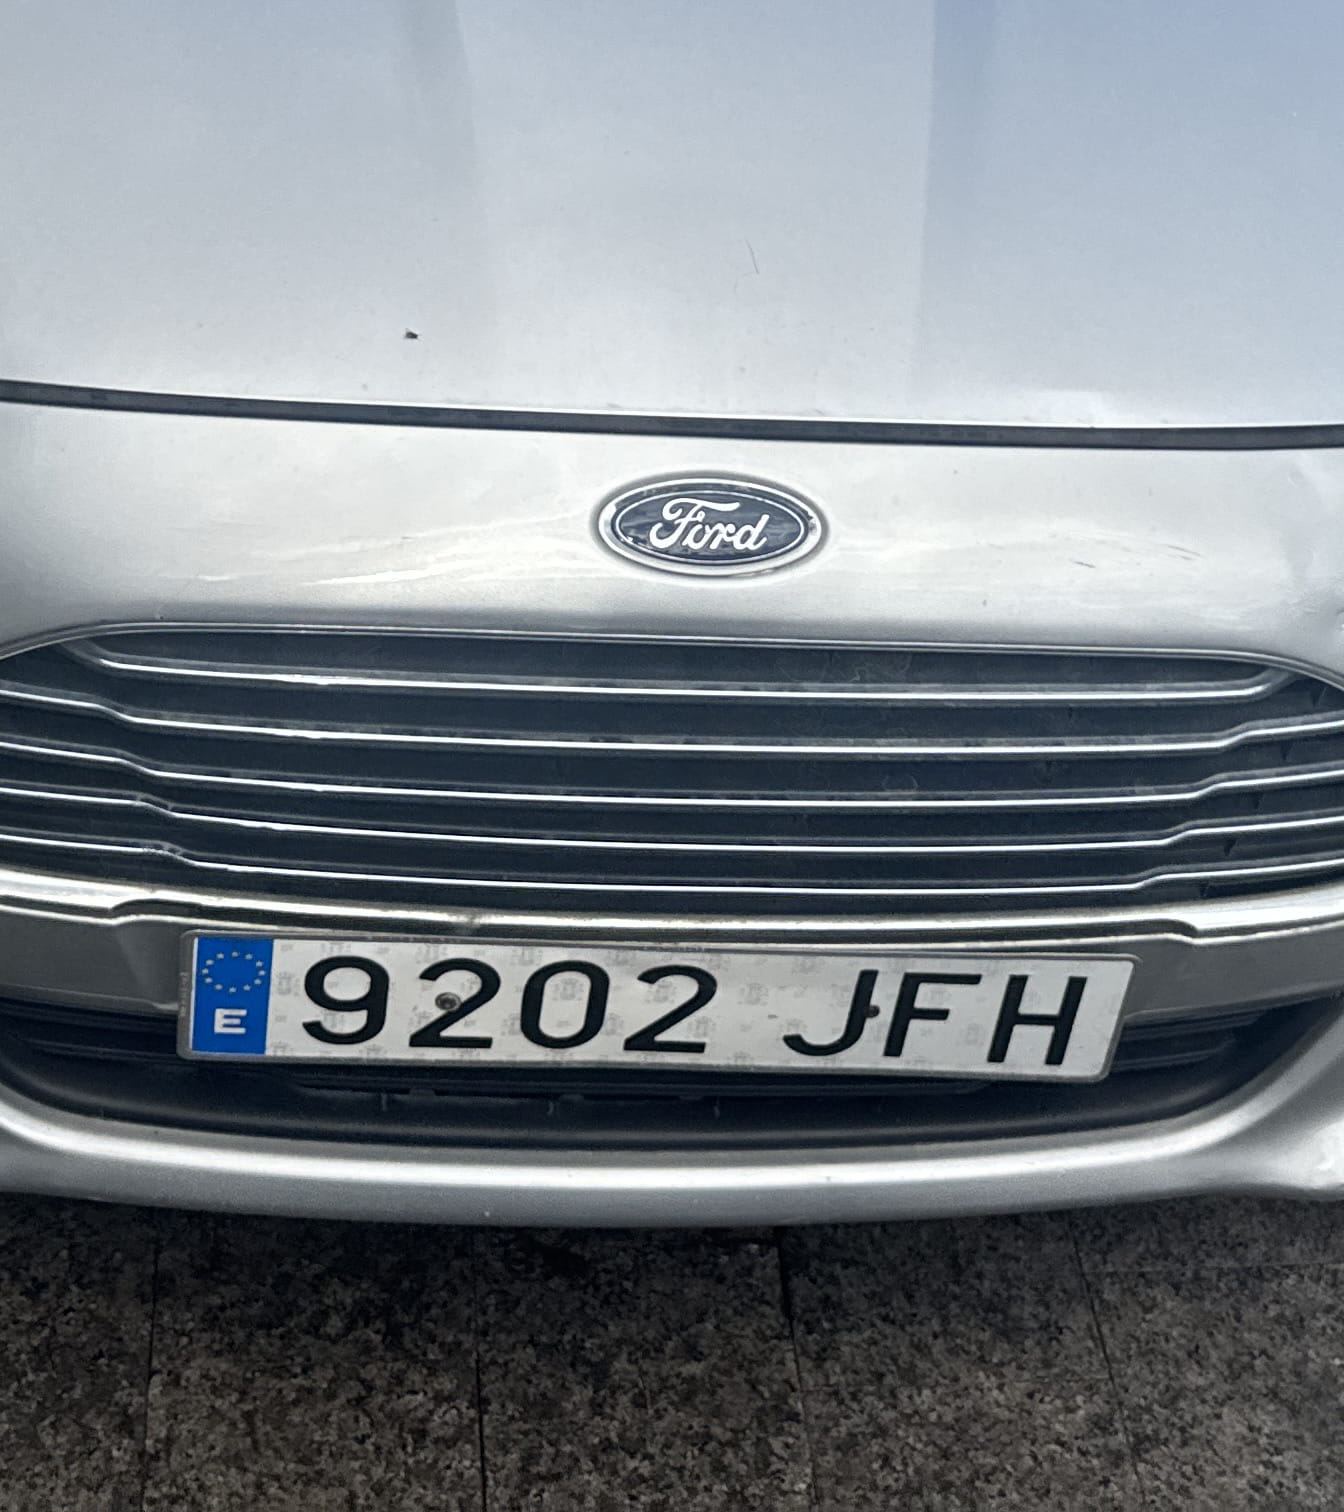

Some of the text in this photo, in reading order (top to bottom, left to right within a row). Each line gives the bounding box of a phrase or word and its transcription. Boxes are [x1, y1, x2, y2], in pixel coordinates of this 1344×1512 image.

[649, 497, 770, 551] Ford
[213, 1008, 248, 1035] E
[302, 956, 717, 1054] 9202
[782, 969, 1088, 1066] JFH
